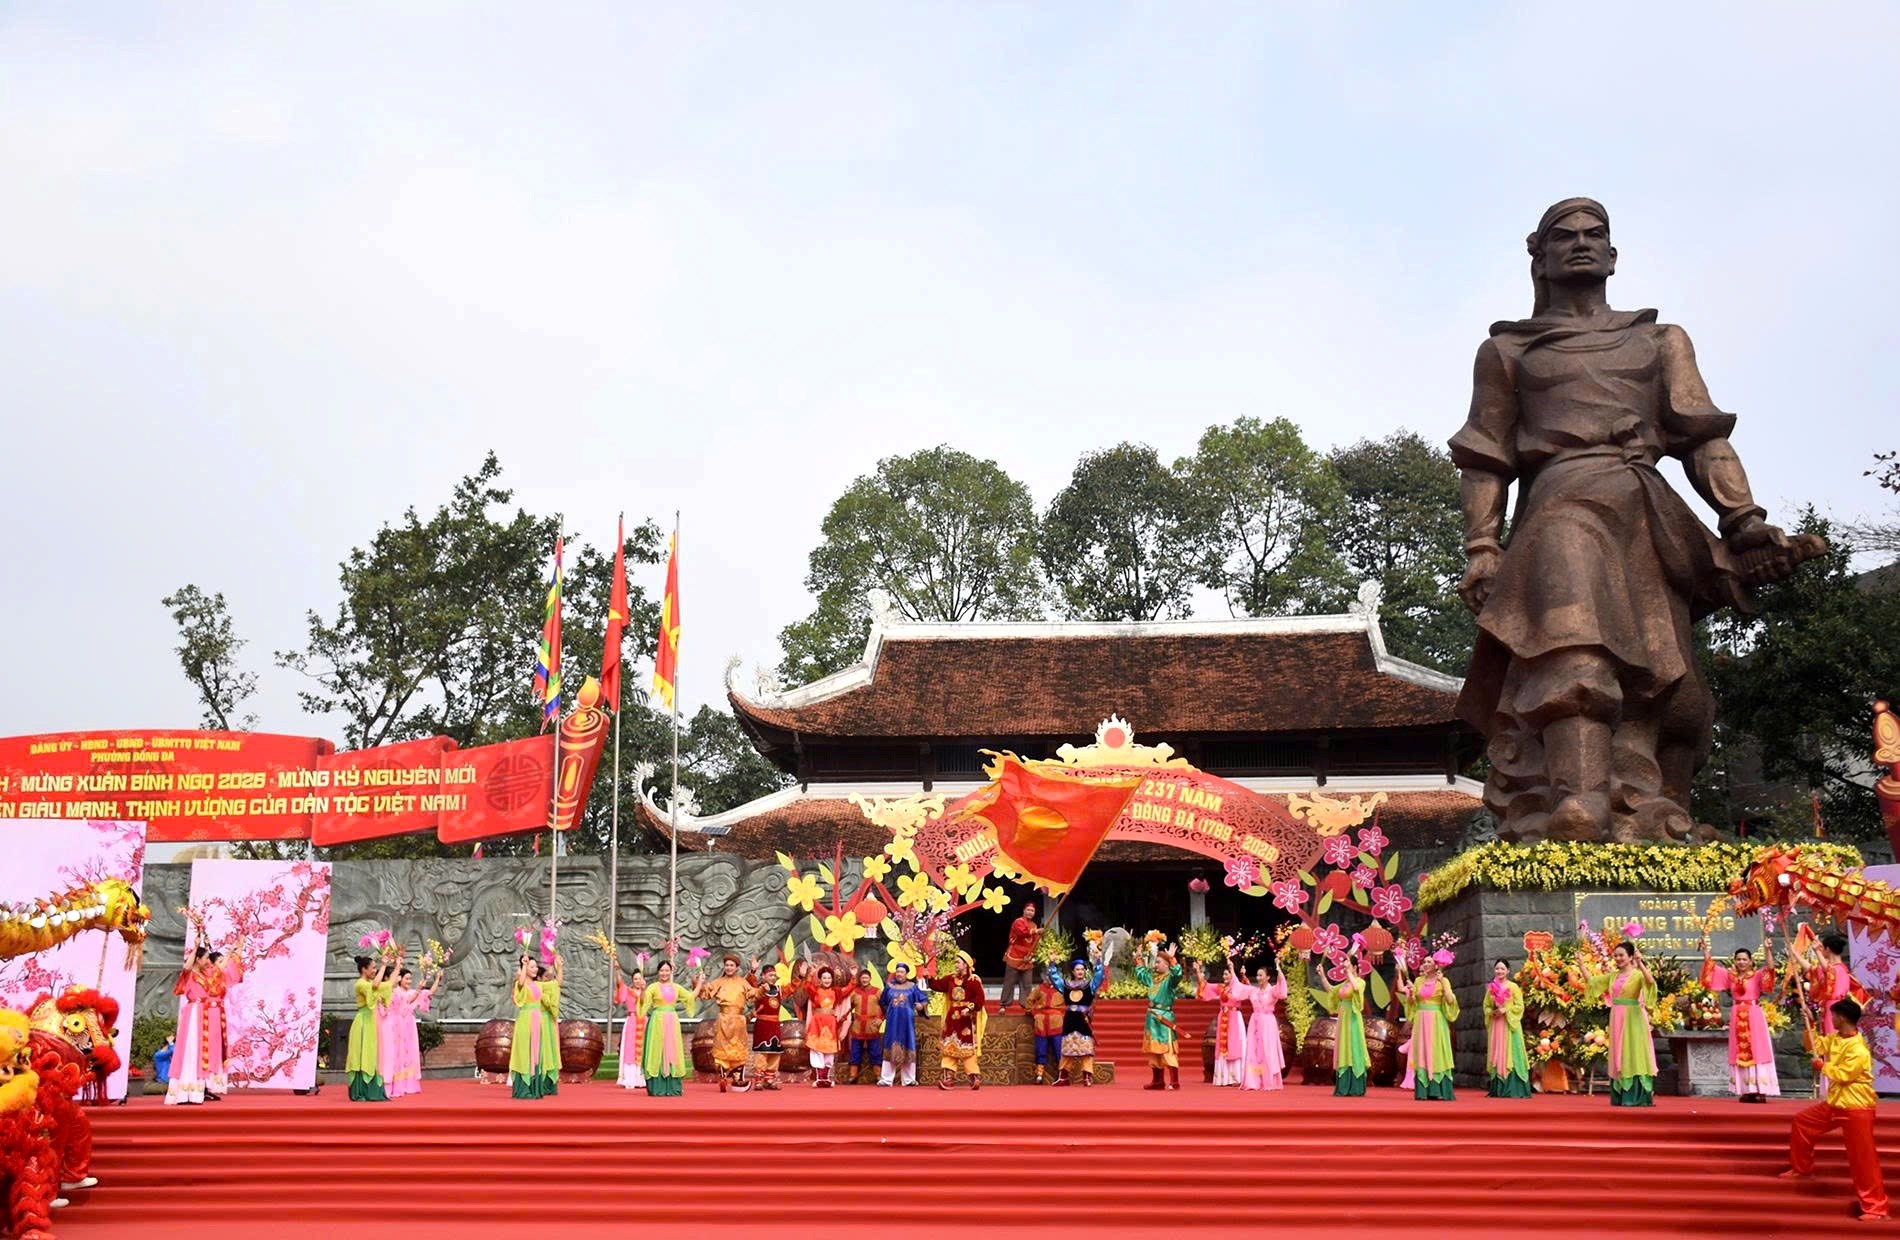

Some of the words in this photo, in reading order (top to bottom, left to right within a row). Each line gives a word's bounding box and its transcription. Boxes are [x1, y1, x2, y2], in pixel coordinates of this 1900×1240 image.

[217, 739, 241, 751] NAM
[21, 770, 73, 792] MỪNG
[76, 770, 127, 792] XUÂN
[130, 769, 174, 791] BÍNH
[177, 773, 215, 794] NGỌ
[217, 772, 267, 789] 2026
[278, 765, 330, 788] MỪNG
[333, 764, 360, 787] KỶ
[363, 764, 441, 786] NGUYÊN
[445, 762, 476, 784] MỚI
[19, 796, 62, 818] GIÀU
[126, 800, 181, 821] THỊNH
[184, 796, 247, 820] VƯỢNG
[249, 793, 287, 815] CỦA
[291, 792, 329, 814] DÂN
[333, 791, 370, 816] TỘC
[373, 790, 417, 816] VIỆT
[1144, 779, 1176, 799] 237
[1179, 786, 1223, 812] NĂM
[1132, 800, 1172, 823] ĐỐNG
[1175, 809, 1195, 830] ĐA
[1640, 897, 1678, 911] HOÀNG
[1681, 896, 1697, 911] ĐẾ
[1686, 935, 1712, 952] HỆ
